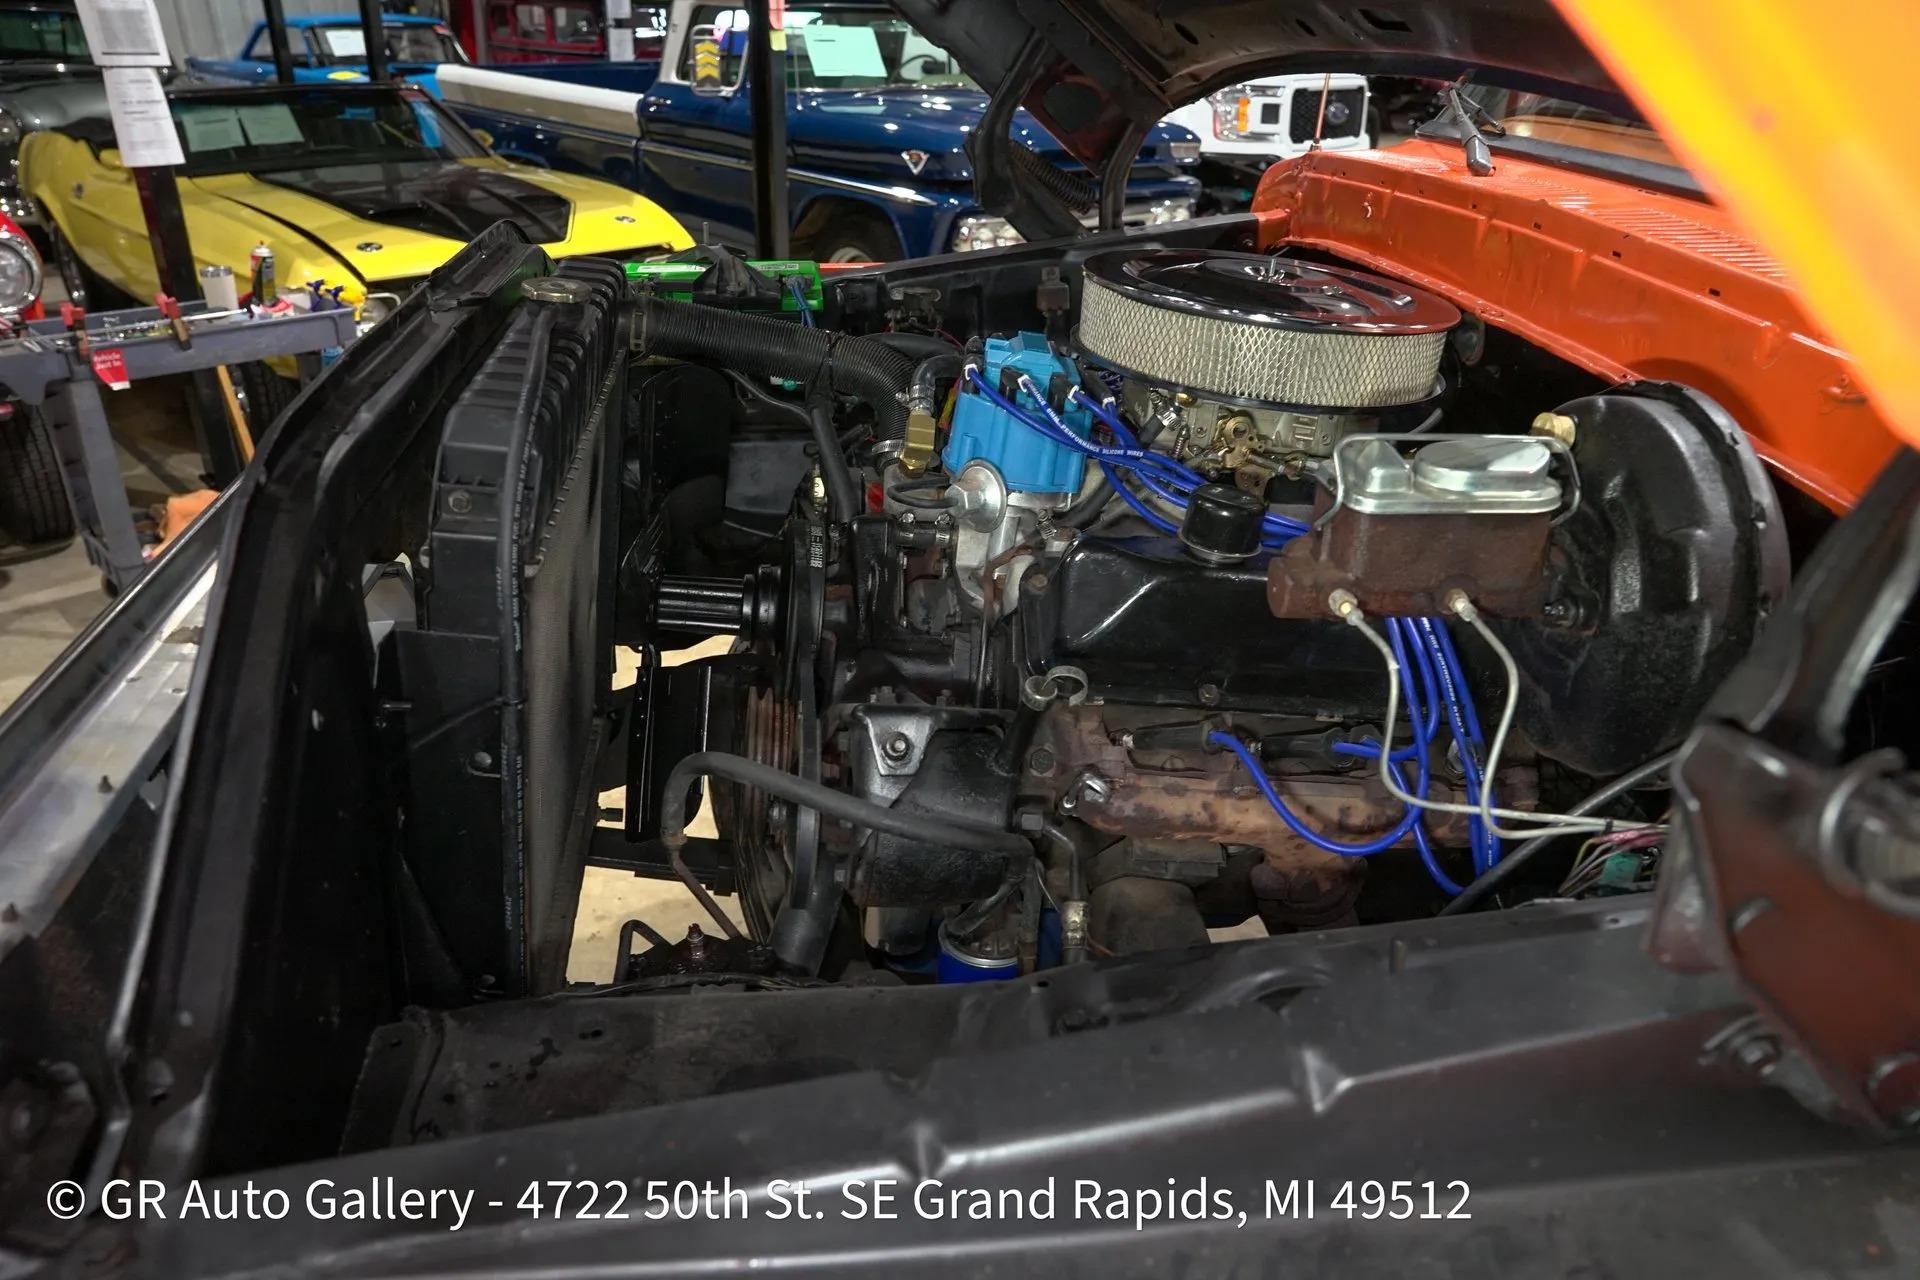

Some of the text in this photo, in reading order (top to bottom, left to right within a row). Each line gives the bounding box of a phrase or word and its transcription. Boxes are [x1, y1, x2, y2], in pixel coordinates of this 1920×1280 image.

[1060, 423, 1099, 453] PERFORMANCE
[1102, 448, 1124, 457] SILICONE
[1126, 449, 1144, 458] WIRES
